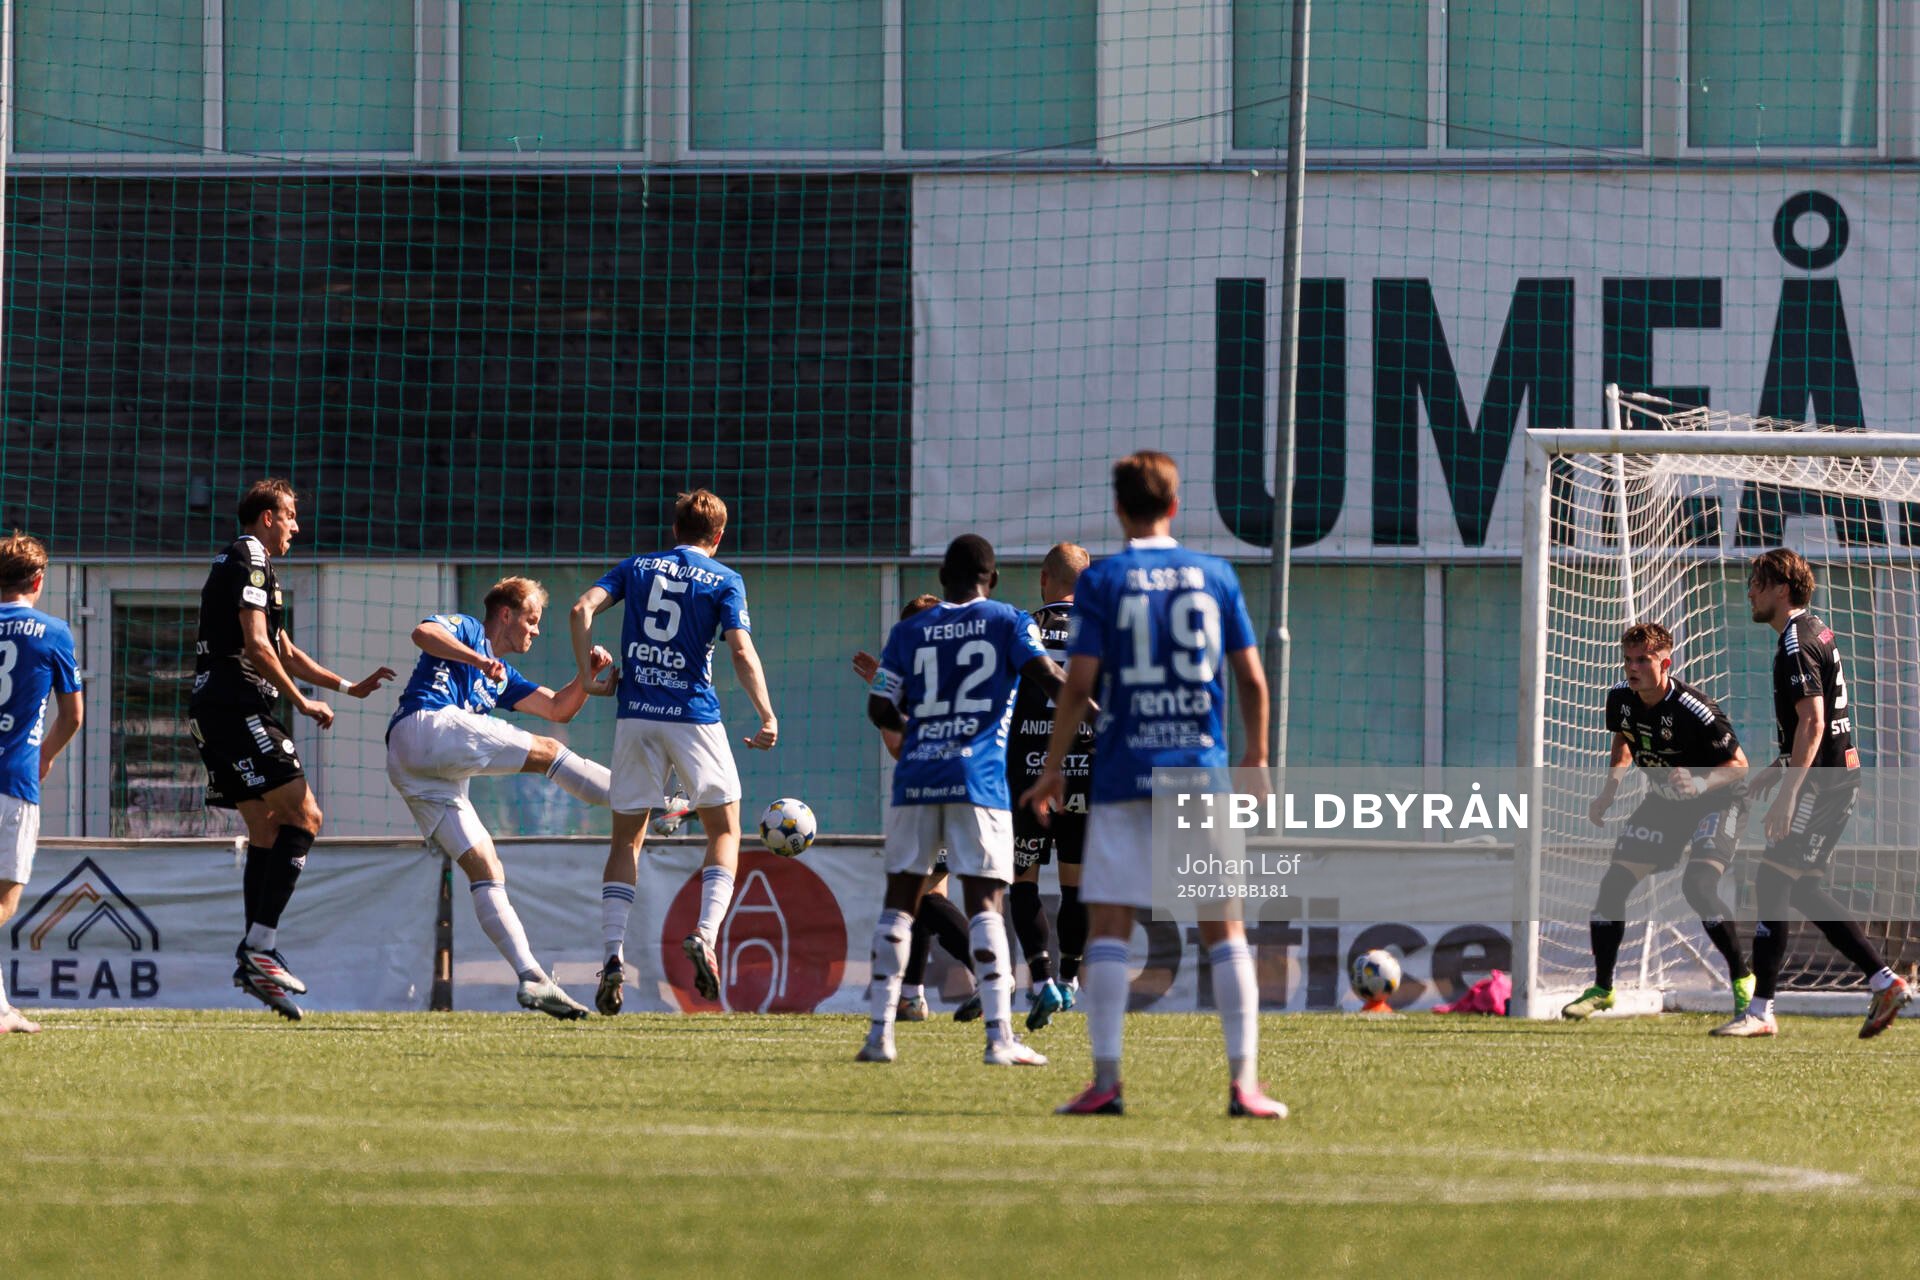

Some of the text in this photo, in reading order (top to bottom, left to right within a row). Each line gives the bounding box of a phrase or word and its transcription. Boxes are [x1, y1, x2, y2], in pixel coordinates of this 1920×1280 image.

[633, 556, 725, 588] HEDENQUIST
[643, 574, 690, 643] 5
[923, 619, 987, 642] YEBOAH
[1116, 591, 1222, 686] 19
[627, 641, 686, 670] renta
[913, 640, 998, 718] 12
[666, 706, 683, 717] AB
[1131, 685, 1213, 717] renta
[917, 715, 980, 741] renta
[10, 958, 161, 1000] LEAB
